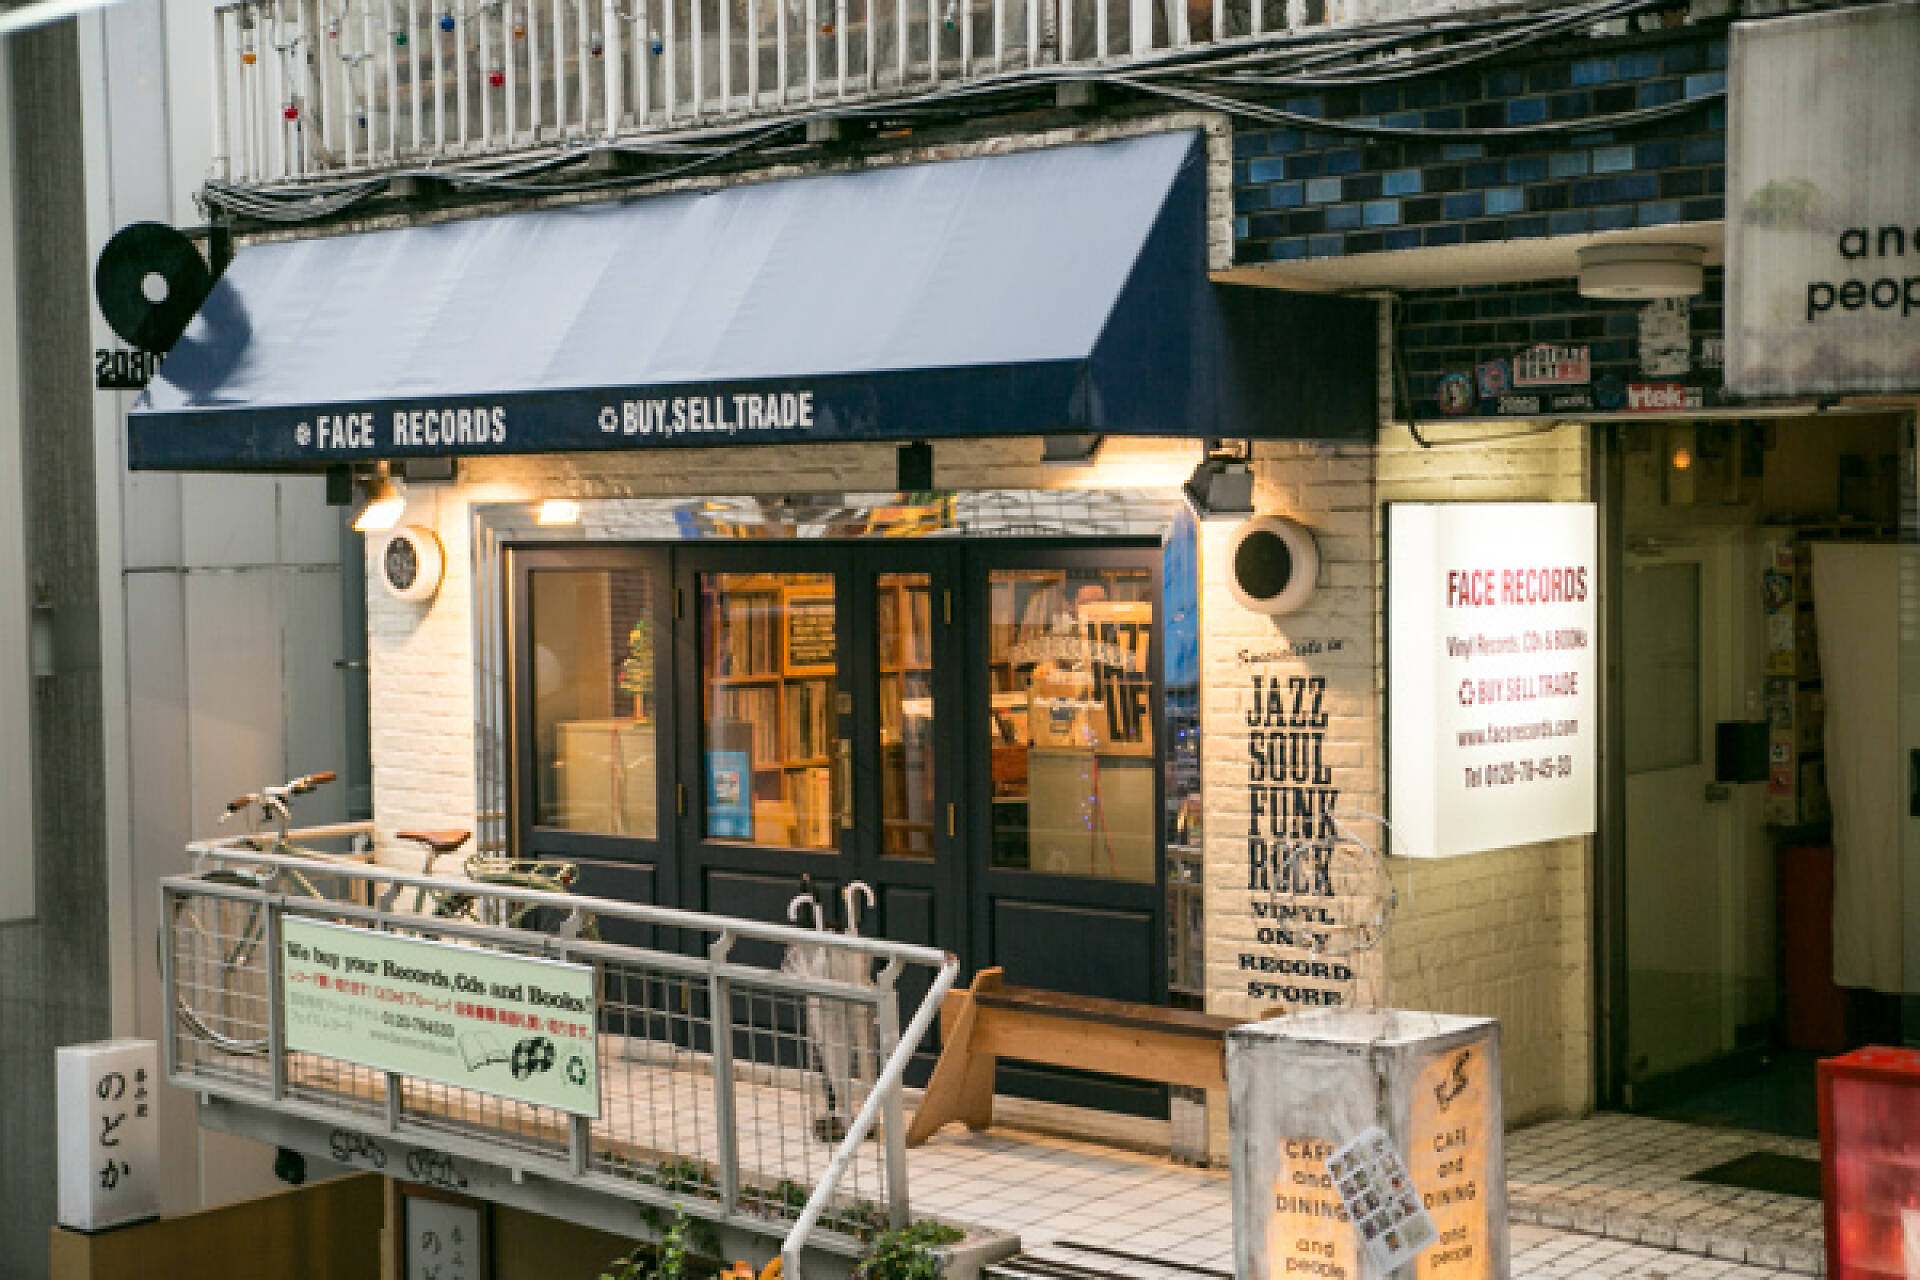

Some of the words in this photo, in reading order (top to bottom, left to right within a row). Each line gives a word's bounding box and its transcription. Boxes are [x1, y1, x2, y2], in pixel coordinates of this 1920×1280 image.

[1838, 224, 1920, 259] an
[316, 413, 375, 449] FACE
[393, 405, 507, 446] RECORDS
[1446, 568, 1496, 608] FACE
[1501, 565, 1588, 603] RECORDS
[1246, 675, 1329, 729] JAZZ
[1247, 732, 1332, 785] SOUL
[1247, 785, 1340, 839] FUNK
[1247, 838, 1335, 897] ROCK
[1250, 902, 1336, 925] VINYL
[1237, 953, 1354, 982] RECORD
[1247, 982, 1343, 1006] STORE
[95, 1071, 132, 1192] のどか
[1295, 1239, 1335, 1258] and
